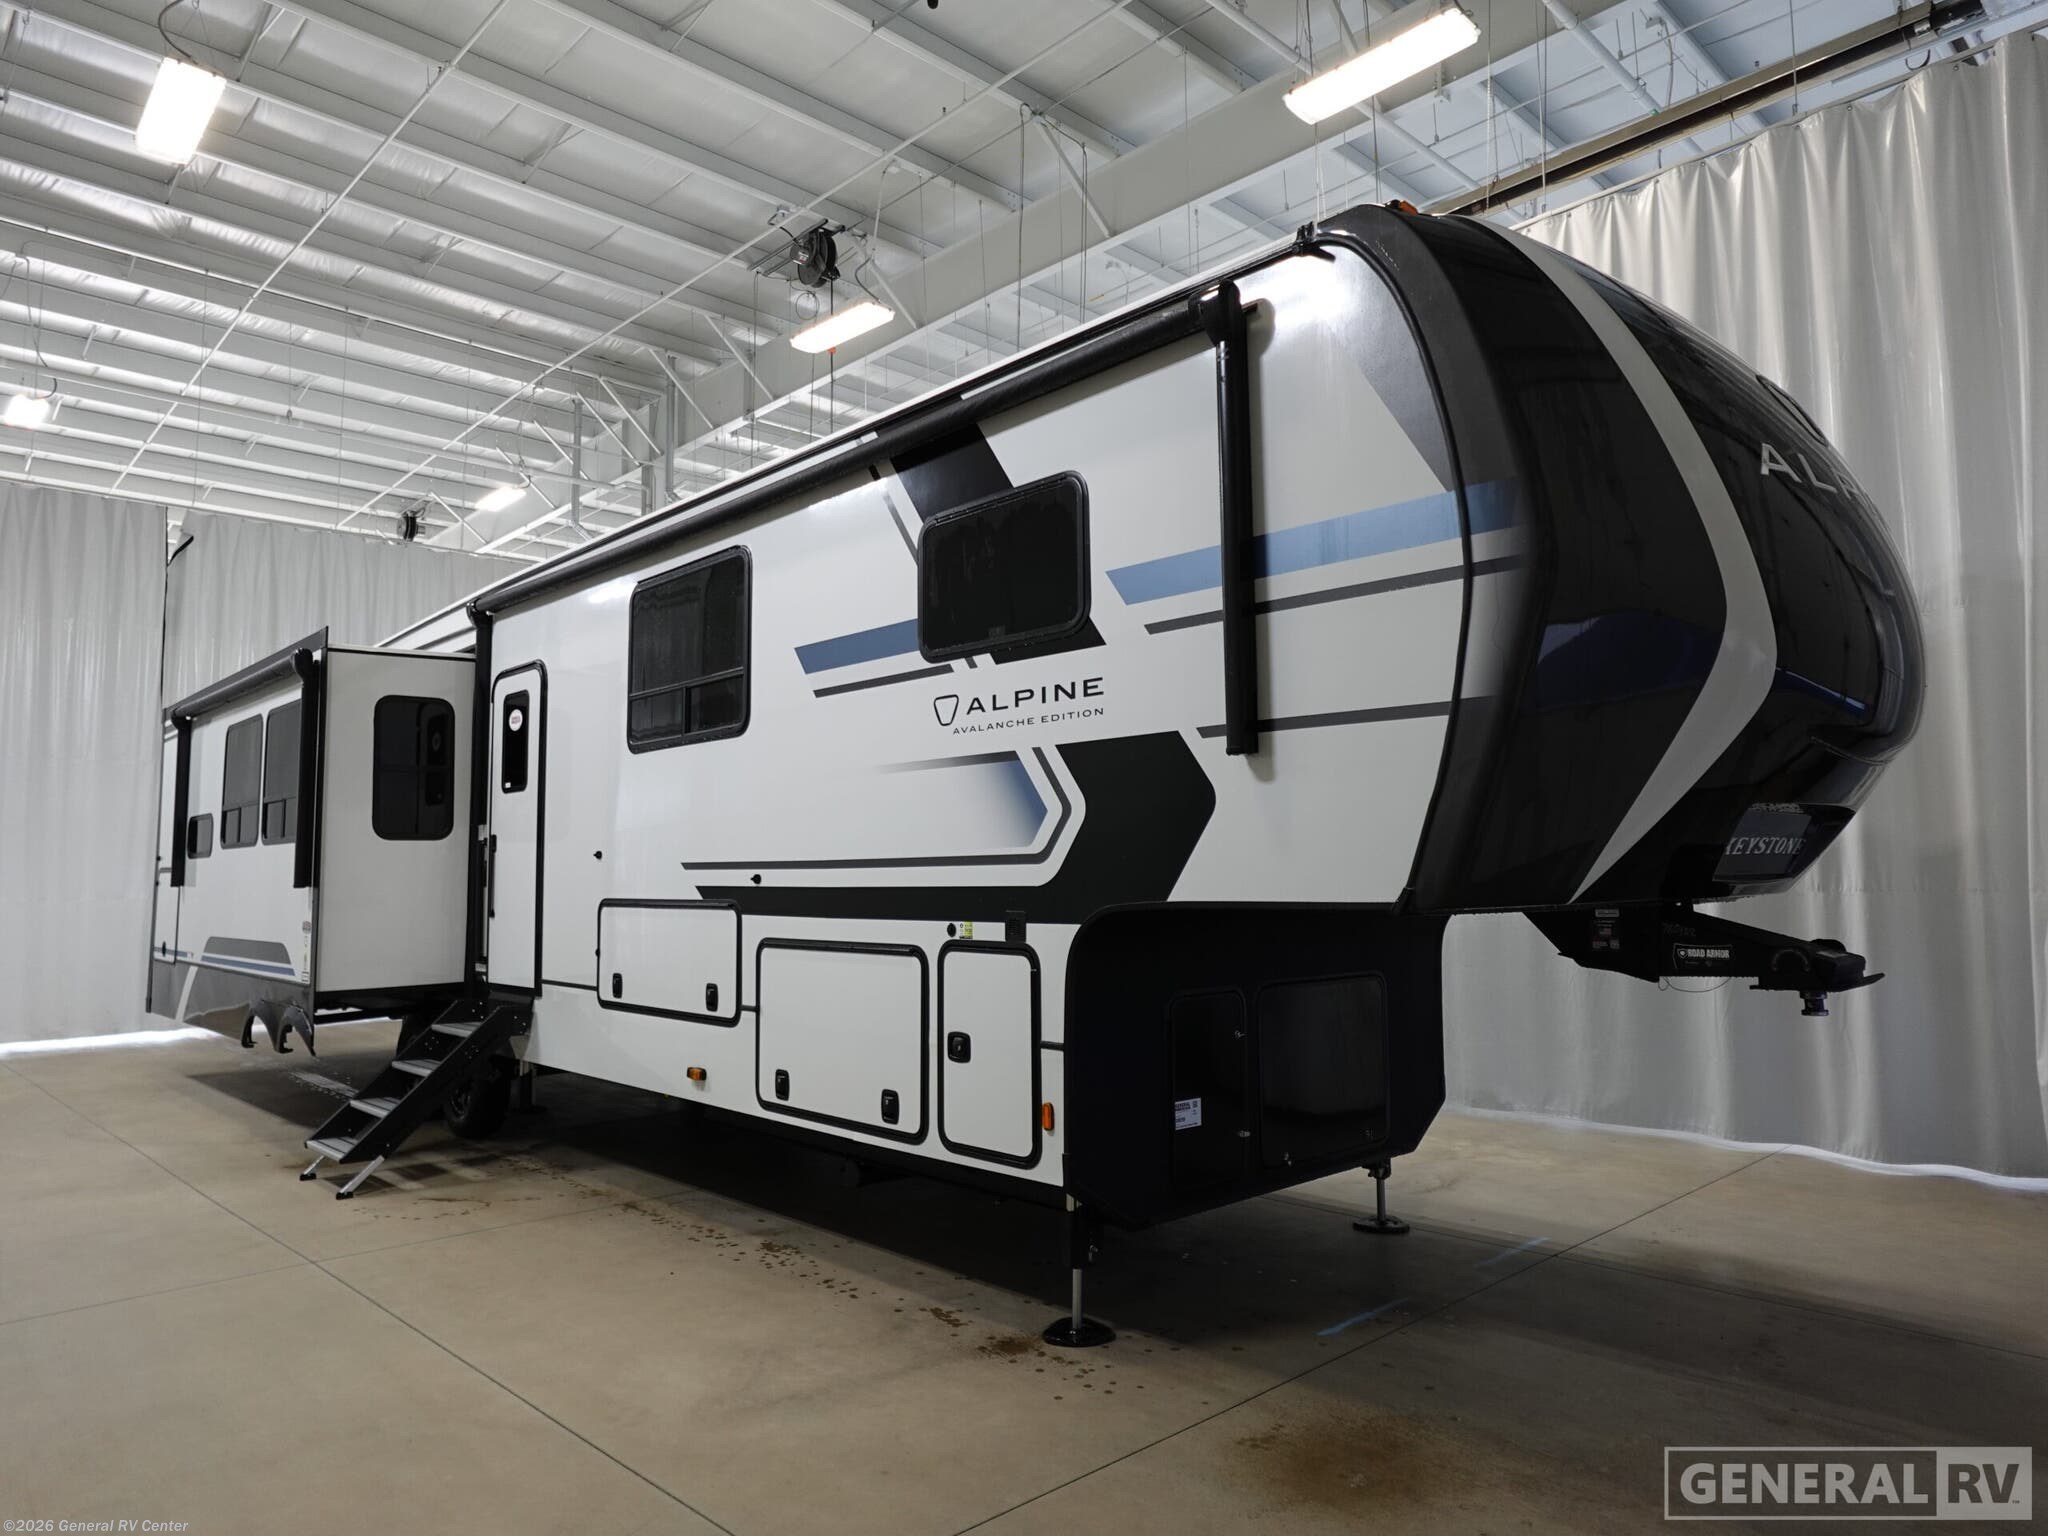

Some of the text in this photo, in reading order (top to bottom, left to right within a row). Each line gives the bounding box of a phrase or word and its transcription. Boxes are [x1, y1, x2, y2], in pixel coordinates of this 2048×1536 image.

[966, 677, 1104, 715] ALPINE
[953, 708, 1104, 735] AVALANCHE EDITION
[1687, 948, 1730, 958] ROAD ARMOR
